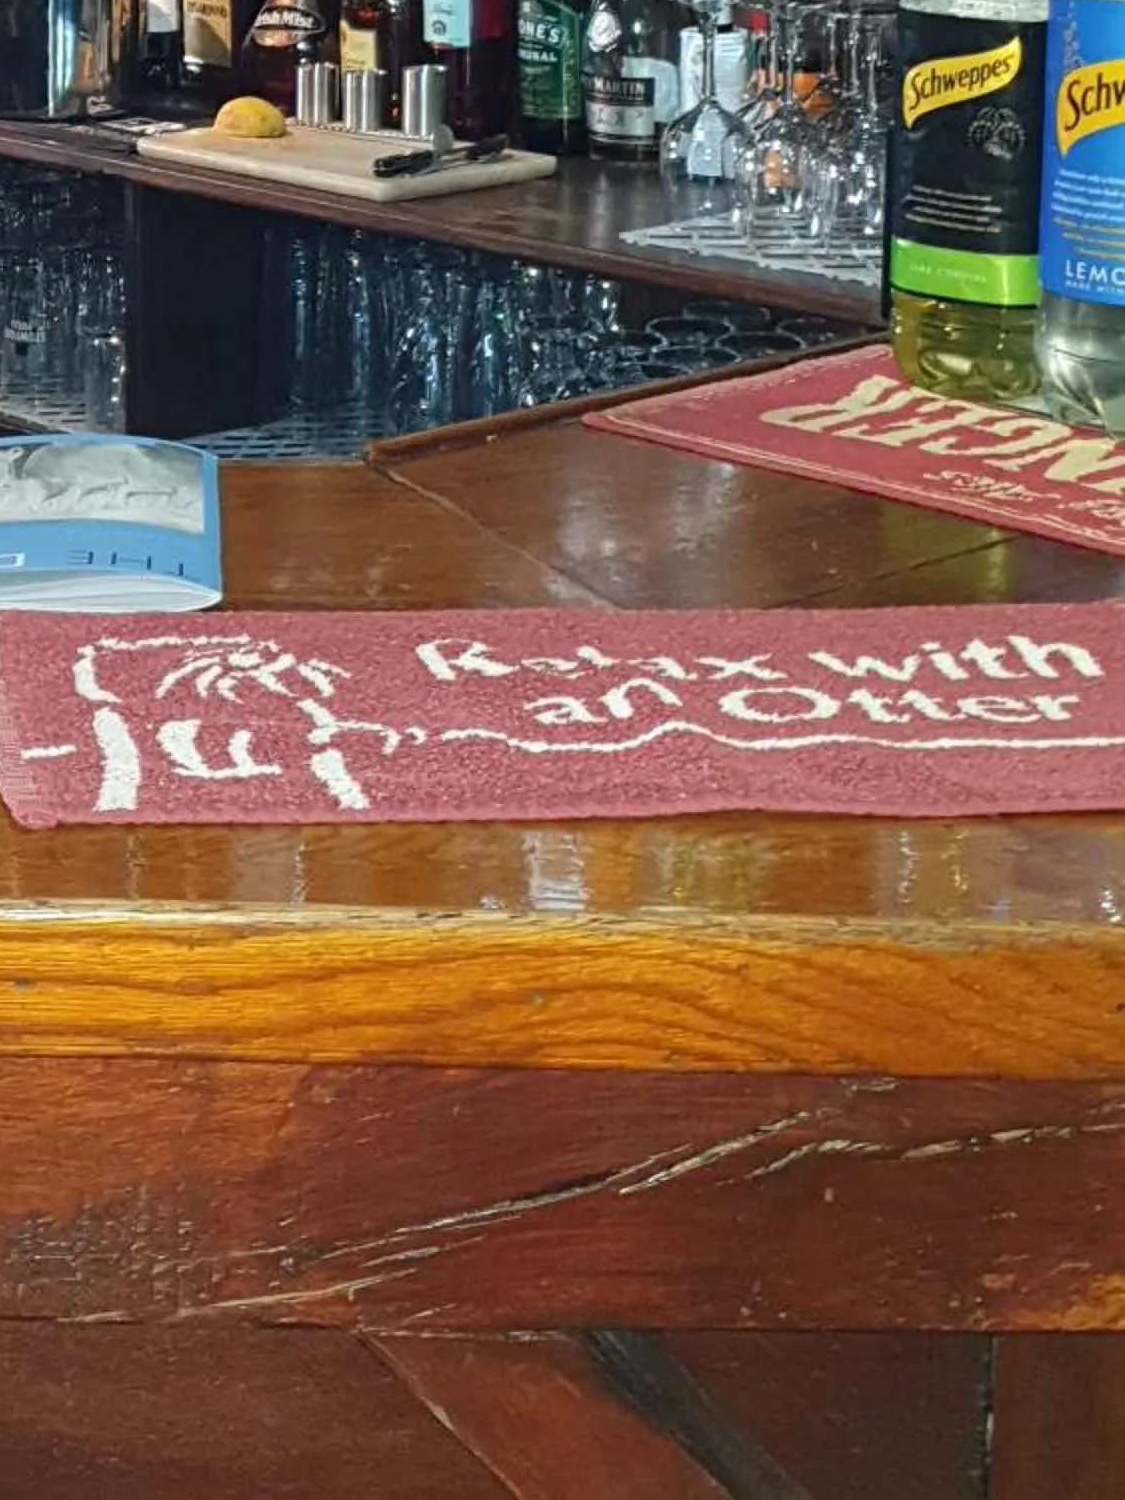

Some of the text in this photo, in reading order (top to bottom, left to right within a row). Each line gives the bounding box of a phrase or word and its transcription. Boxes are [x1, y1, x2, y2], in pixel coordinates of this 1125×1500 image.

[518, 18, 561, 43] ONE'S
[908, 55, 1013, 111] Schweppes
[1065, 258, 1125, 286] LEMO
[809, 634, 1106, 682] with
[525, 675, 1080, 727] an Otter
